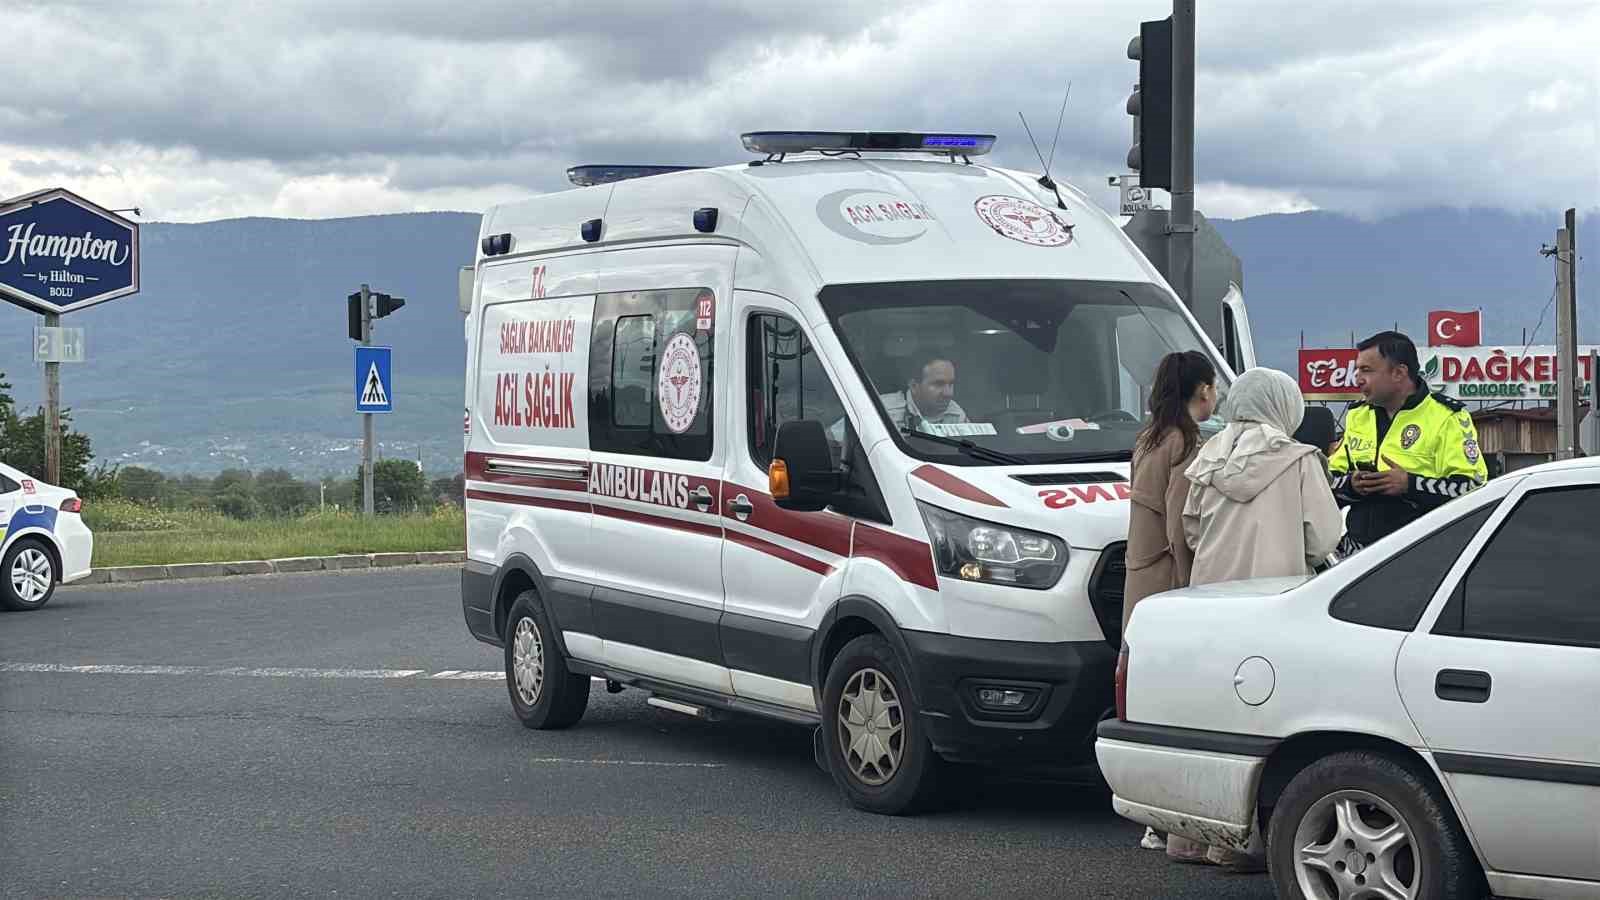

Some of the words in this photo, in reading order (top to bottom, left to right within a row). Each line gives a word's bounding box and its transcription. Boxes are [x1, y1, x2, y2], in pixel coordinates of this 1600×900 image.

[0, 223, 129, 266] Hampton
[38, 272, 49, 284] by
[50, 270, 85, 283] Hilton
[49, 287, 73, 297] BOLU
[500, 318, 527, 354] SAĞLIK
[527, 315, 576, 353] BAKANLIĞI
[1442, 349, 1591, 382] DAĞKET
[525, 362, 576, 429] SAĞLIK
[590, 463, 689, 509] AMBULANS
